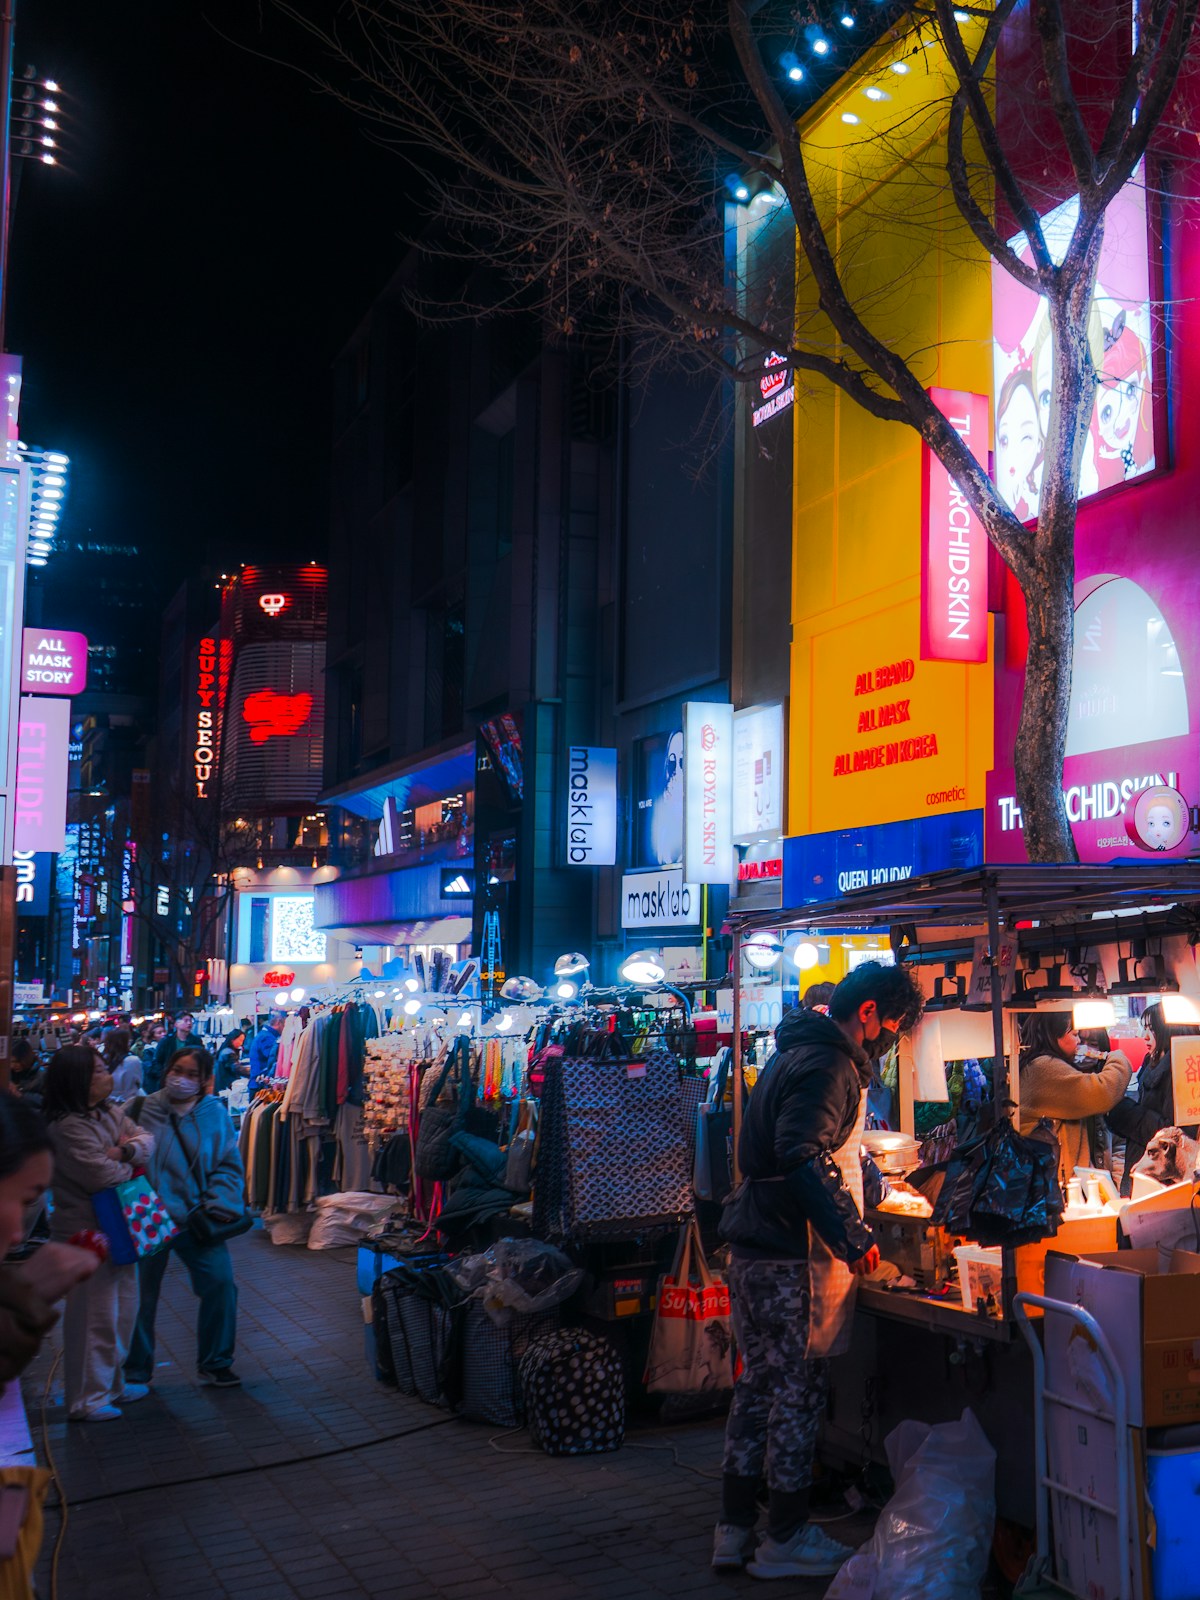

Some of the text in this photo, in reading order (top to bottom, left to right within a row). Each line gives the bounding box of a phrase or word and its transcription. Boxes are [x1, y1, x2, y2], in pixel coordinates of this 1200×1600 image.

[29, 654, 72, 668] MASK
[38, 639, 66, 651] ALL
[26, 670, 74, 684] STORY
[854, 659, 915, 696] ALL BRAND
[194, 638, 216, 799] SUPY SEOUL
[858, 699, 911, 733] ALL MASK
[833, 733, 938, 777] ALL MADE IN KOREA
[15, 721, 46, 828] ETUDE
[703, 760, 717, 866] ROYAL SKIN
[838, 871, 868, 892] QUEEN
